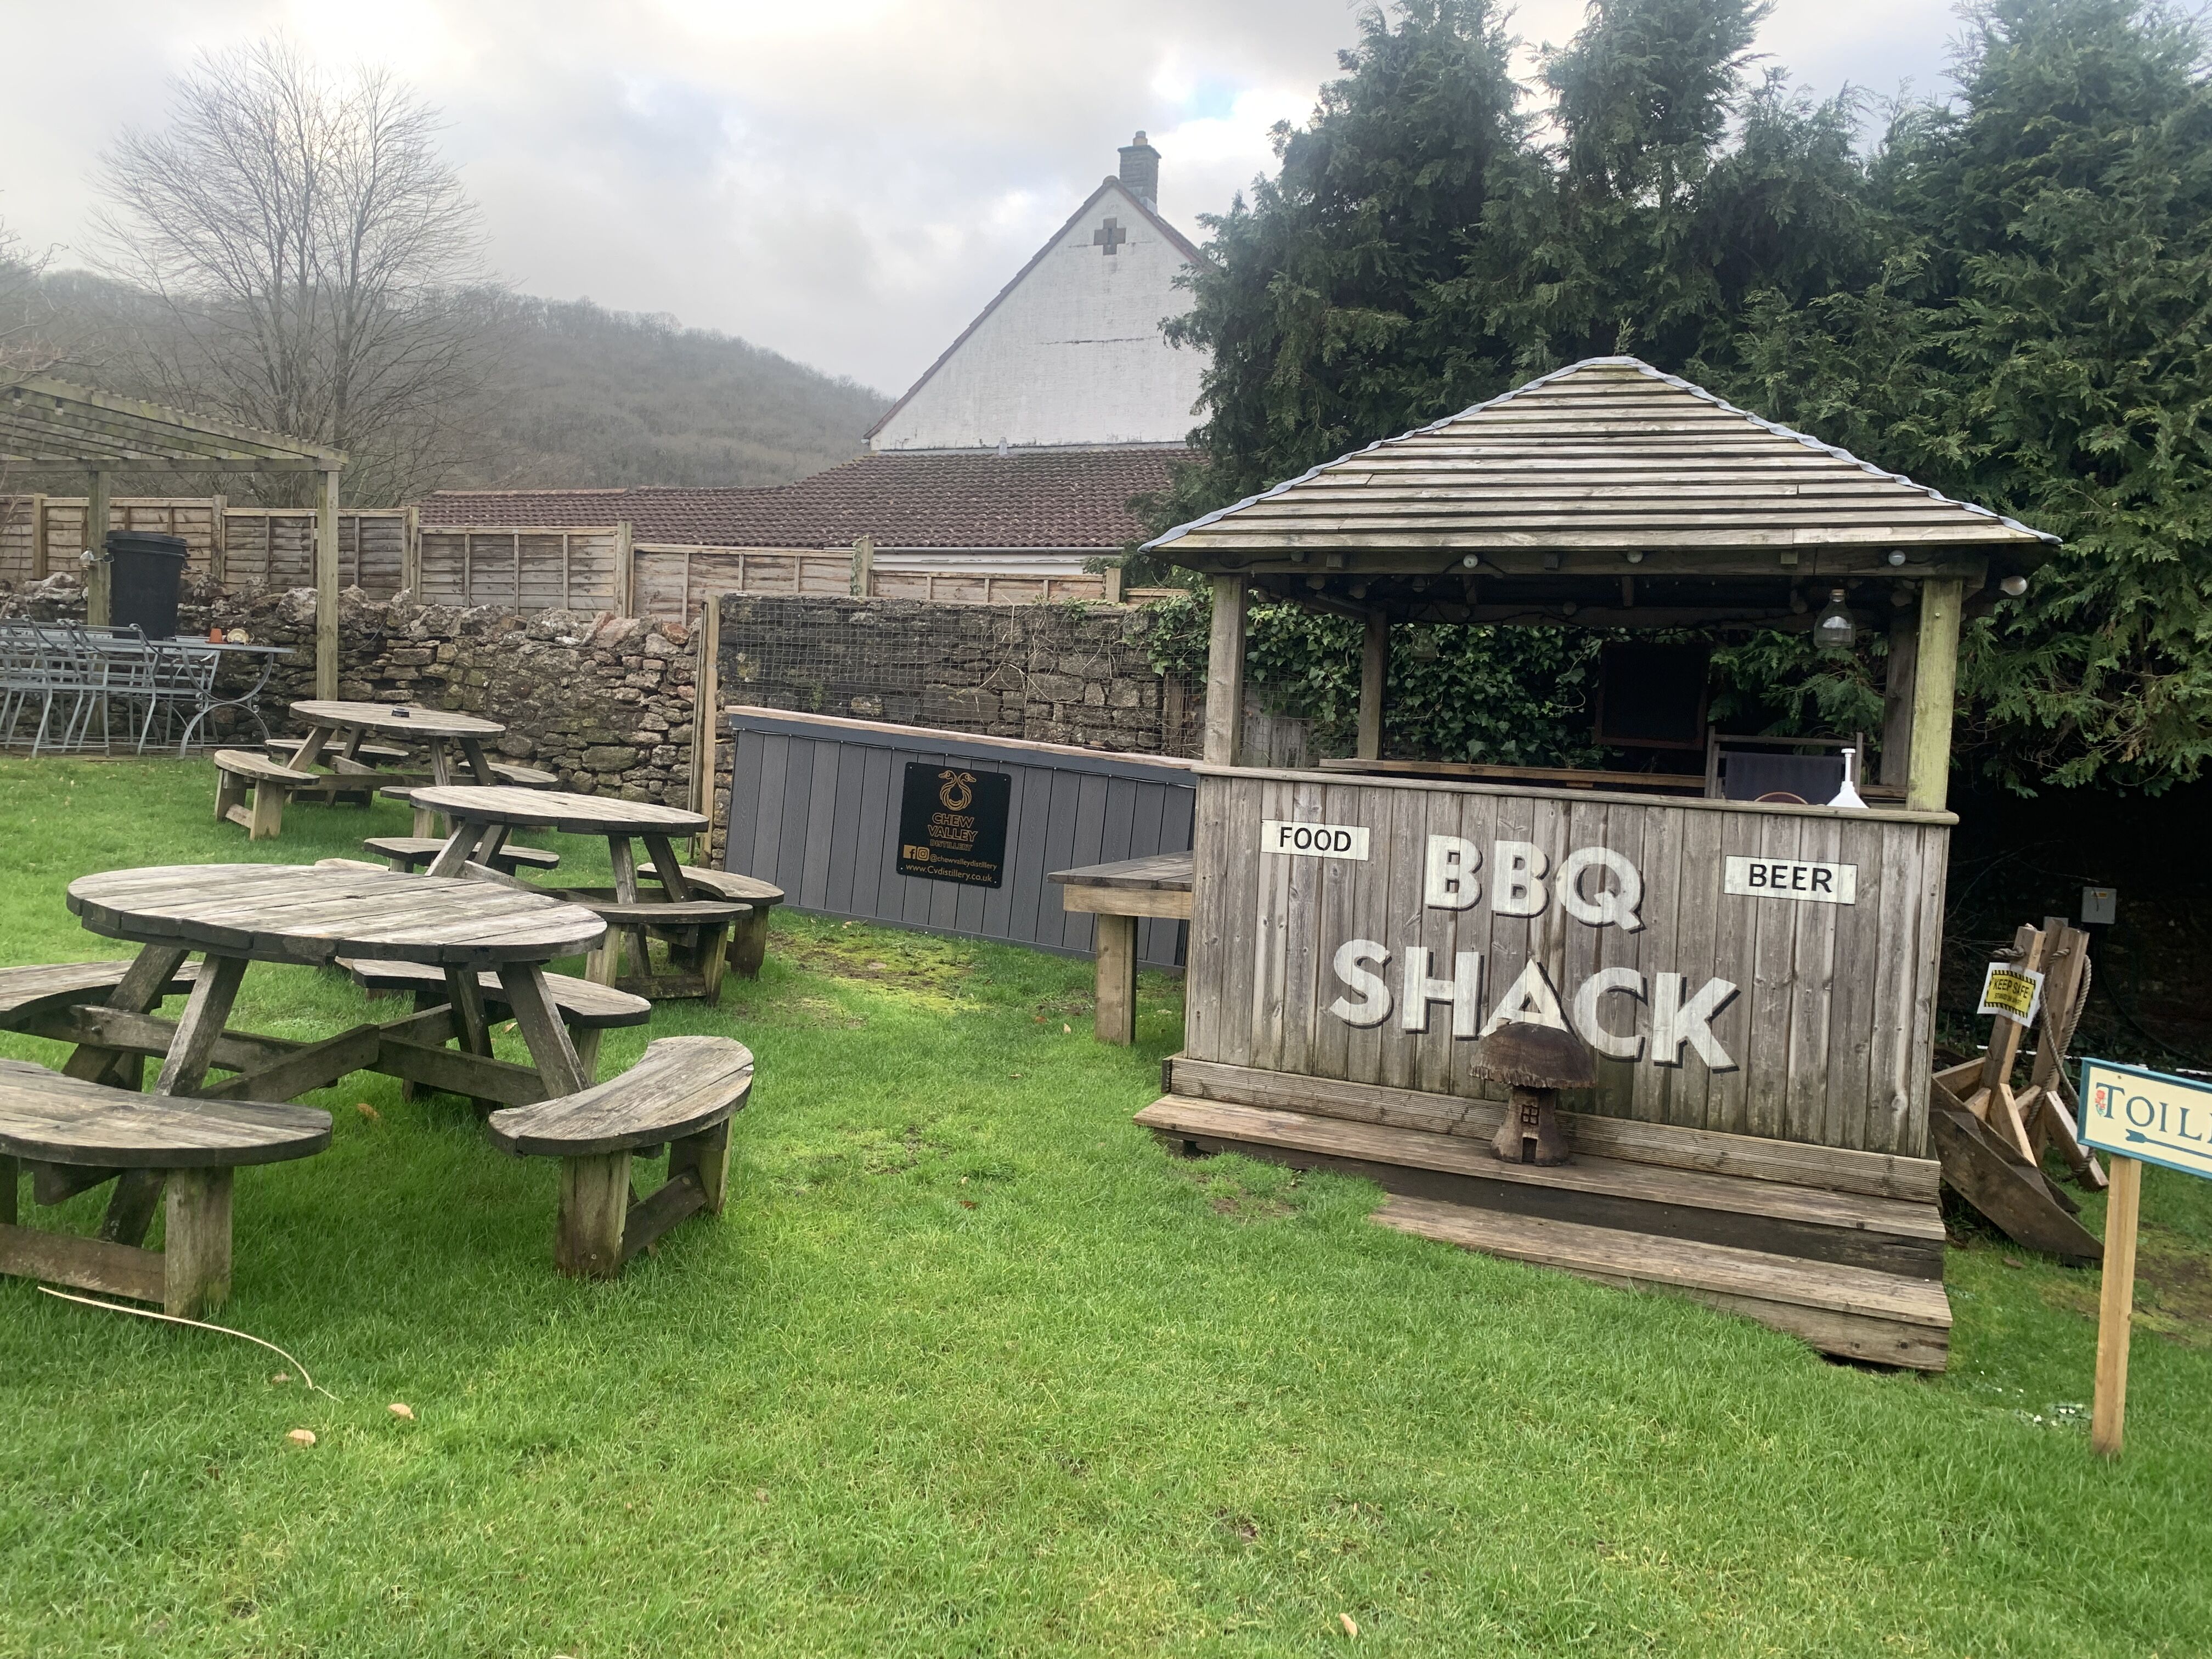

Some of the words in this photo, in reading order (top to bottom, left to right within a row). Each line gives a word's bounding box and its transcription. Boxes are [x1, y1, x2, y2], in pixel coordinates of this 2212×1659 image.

[932, 812, 974, 828] CHEW
[928, 825, 978, 842] VALLEY
[1279, 826, 1352, 854] FOOD
[930, 839, 973, 851] DISTILLERY
[930, 854, 997, 871] @chewvalleydistillery
[906, 864, 992, 882] www.Cvdistillery.co.uk
[1748, 863, 1833, 894] BEER
[1424, 834, 1645, 934] BBQ
[1993, 978, 2012, 991] KEEP
[2012, 981, 2030, 998] SAFE
[1328, 938, 1740, 1073] SHACK
[2095, 1082, 2212, 1144] TOIL
